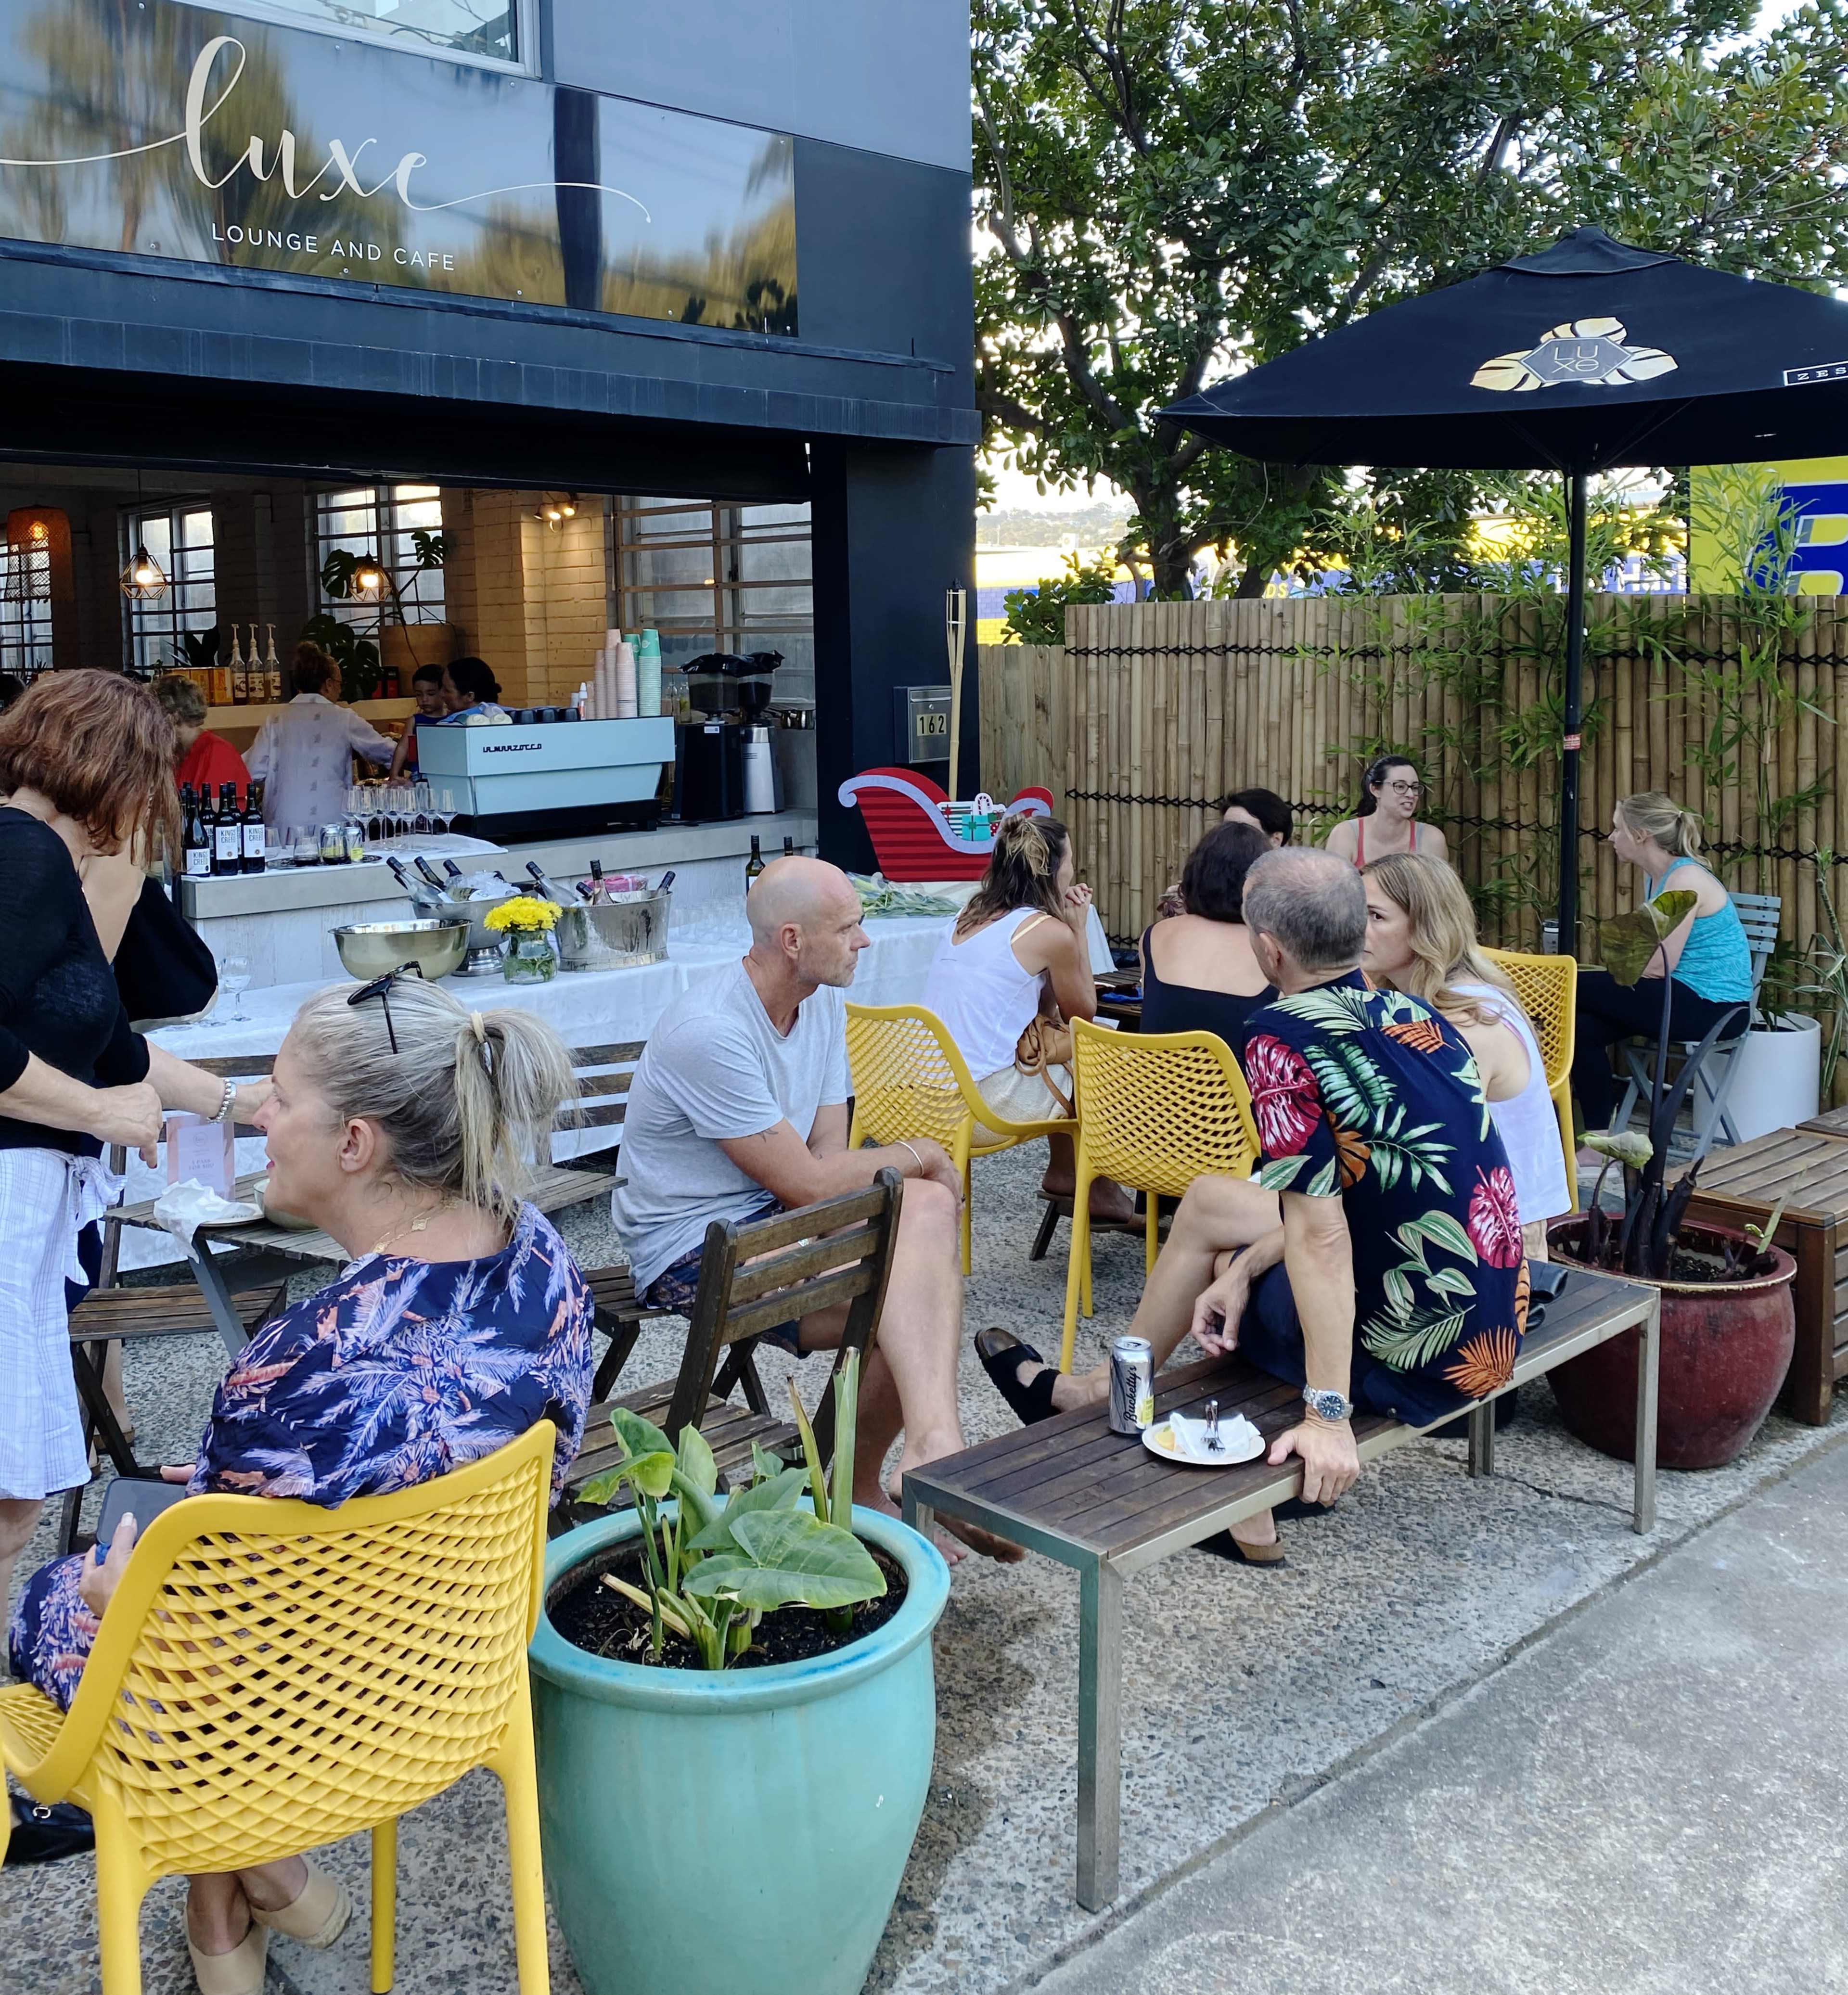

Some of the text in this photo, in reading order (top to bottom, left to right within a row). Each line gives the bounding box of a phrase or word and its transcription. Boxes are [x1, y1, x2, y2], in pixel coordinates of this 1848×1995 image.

[185, 35, 436, 211] luxe
[212, 222, 454, 271] LOUNGE AND CAFE
[920, 715, 945, 734] 162
[1123, 1365, 1142, 1423] Bucketty's
